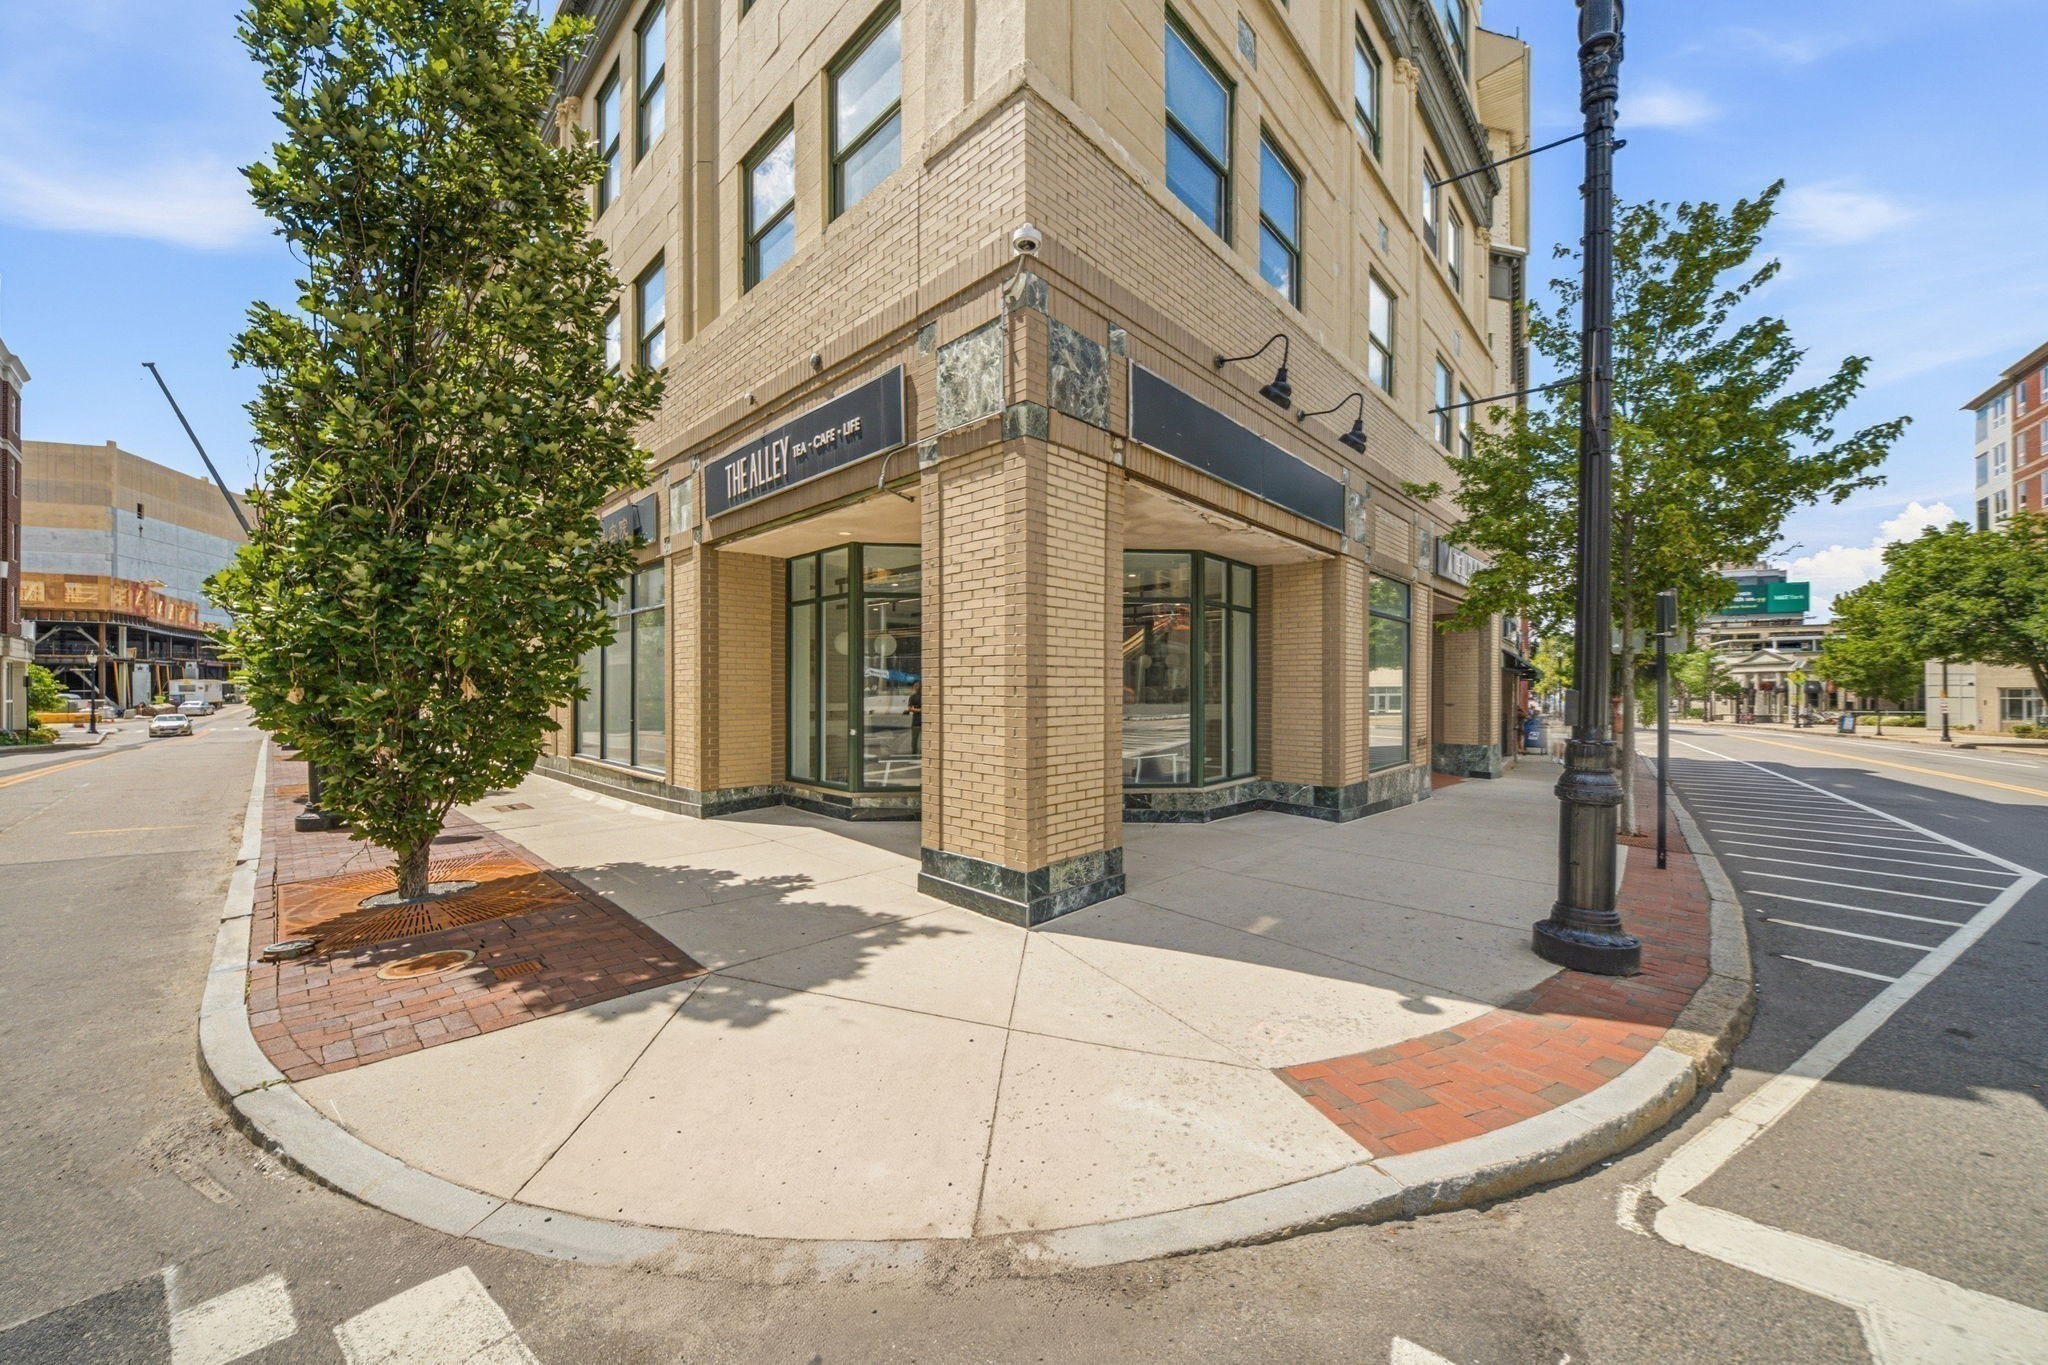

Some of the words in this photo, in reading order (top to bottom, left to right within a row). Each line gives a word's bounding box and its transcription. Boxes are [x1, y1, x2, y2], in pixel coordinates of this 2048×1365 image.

[724, 456, 748, 499] THE
[749, 435, 790, 490] ALLEY
[791, 443, 807, 458] TEA
[812, 427, 836, 449] CAFE
[842, 416, 861, 437] LIFE
